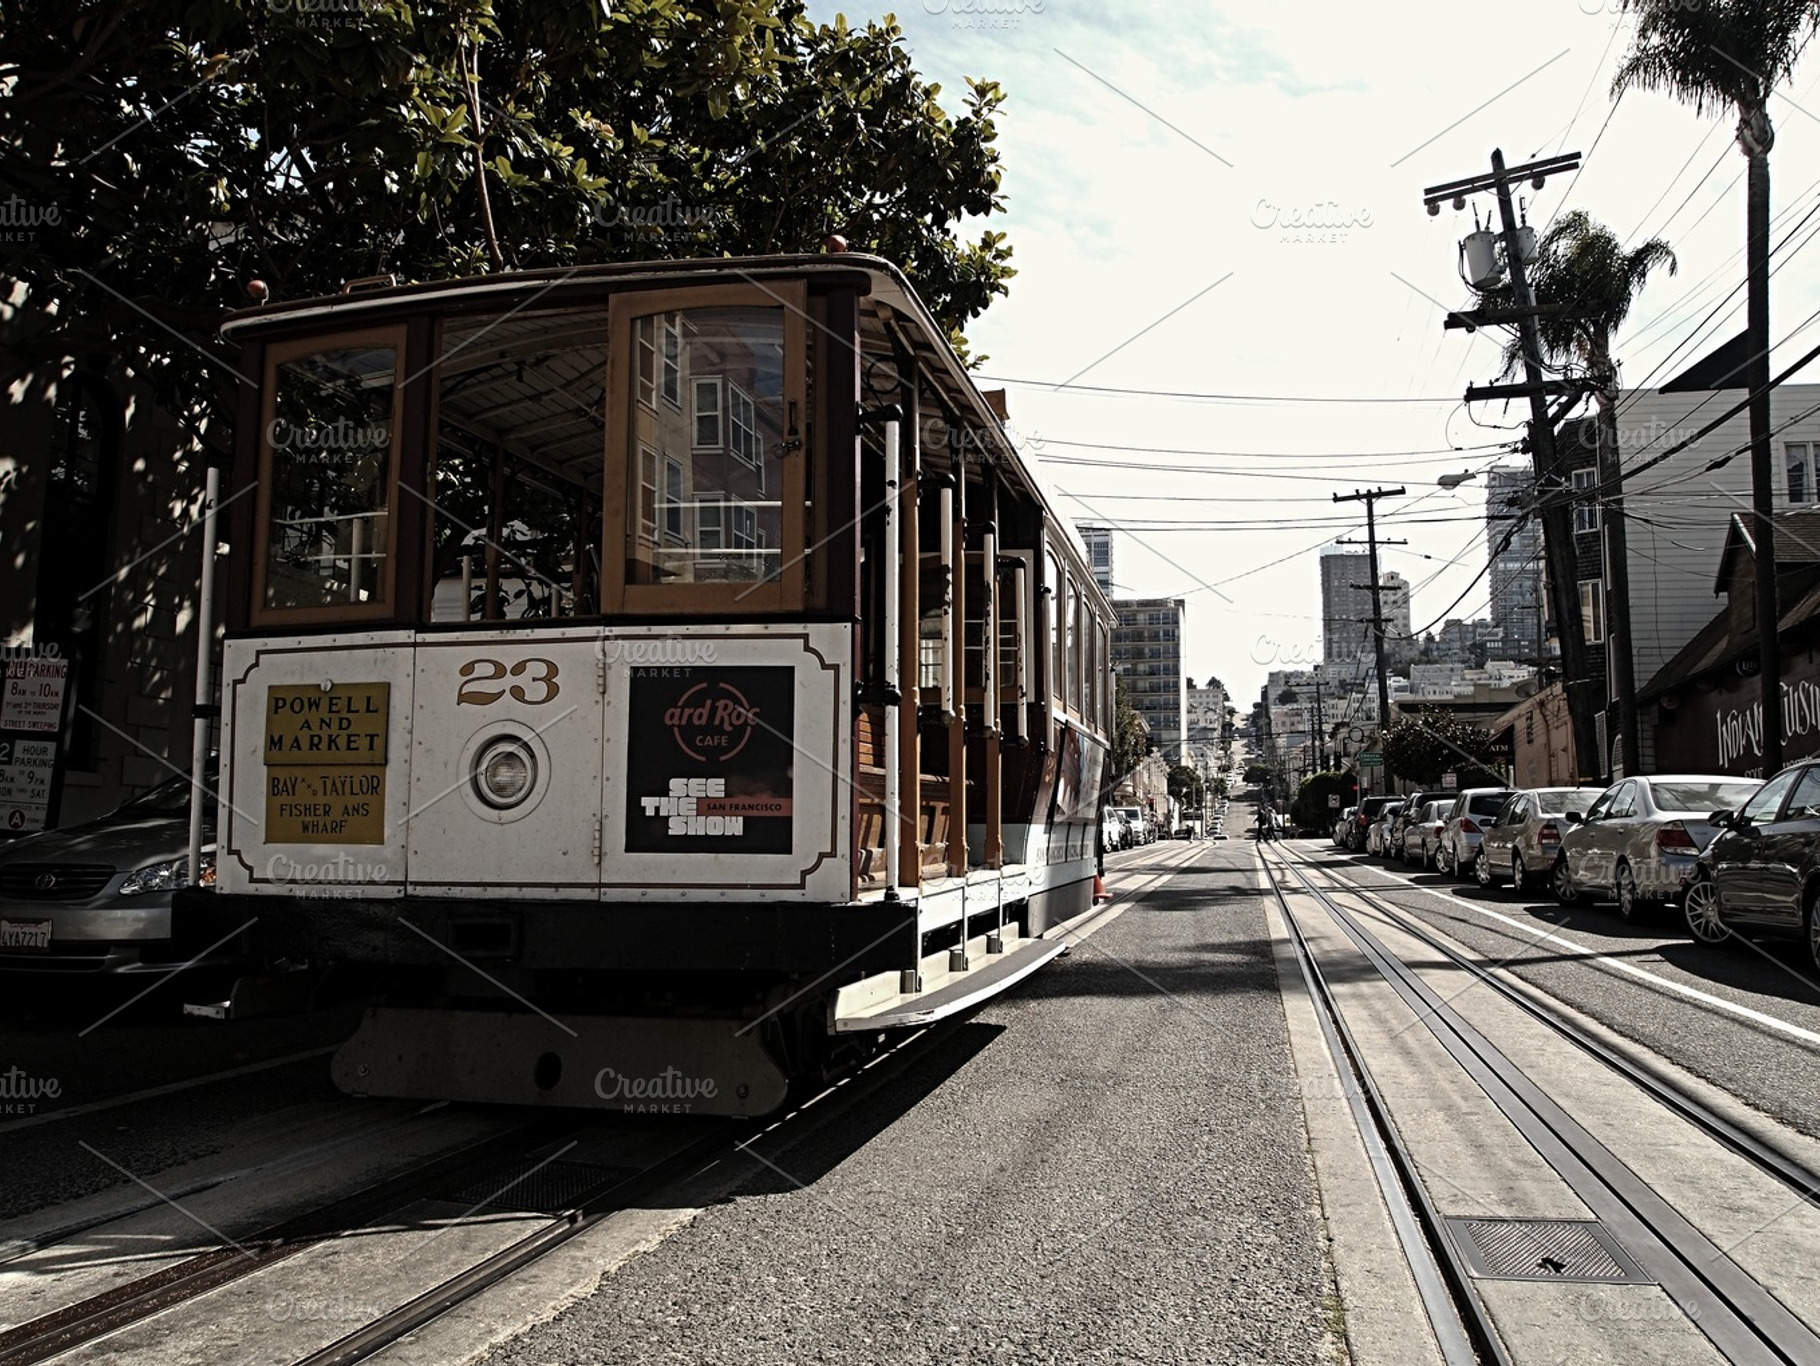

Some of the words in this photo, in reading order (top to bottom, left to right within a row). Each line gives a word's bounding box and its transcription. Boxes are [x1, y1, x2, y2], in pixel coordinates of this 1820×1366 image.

[28, 663, 67, 679] PARKING
[456, 657, 560, 707] 23
[273, 696, 379, 715] POWELL
[3, 719, 26, 727] STREET
[28, 720, 57, 729] SWEEPING
[299, 716, 352, 731] AND
[269, 733, 380, 751] MARKET
[696, 735, 729, 746] CAFE
[23, 745, 48, 756] HOUR
[14, 757, 54, 769] PARKING
[271, 776, 298, 797] BAY
[320, 775, 380, 796] TAYLOR
[669, 778, 725, 797] SEE
[30, 789, 46, 799] SAT
[640, 796, 697, 816] THE
[706, 803, 726, 812] SAN
[729, 803, 782, 812] FRANCISCO
[301, 819, 347, 834] WHARF
[668, 816, 744, 836] SHOW
